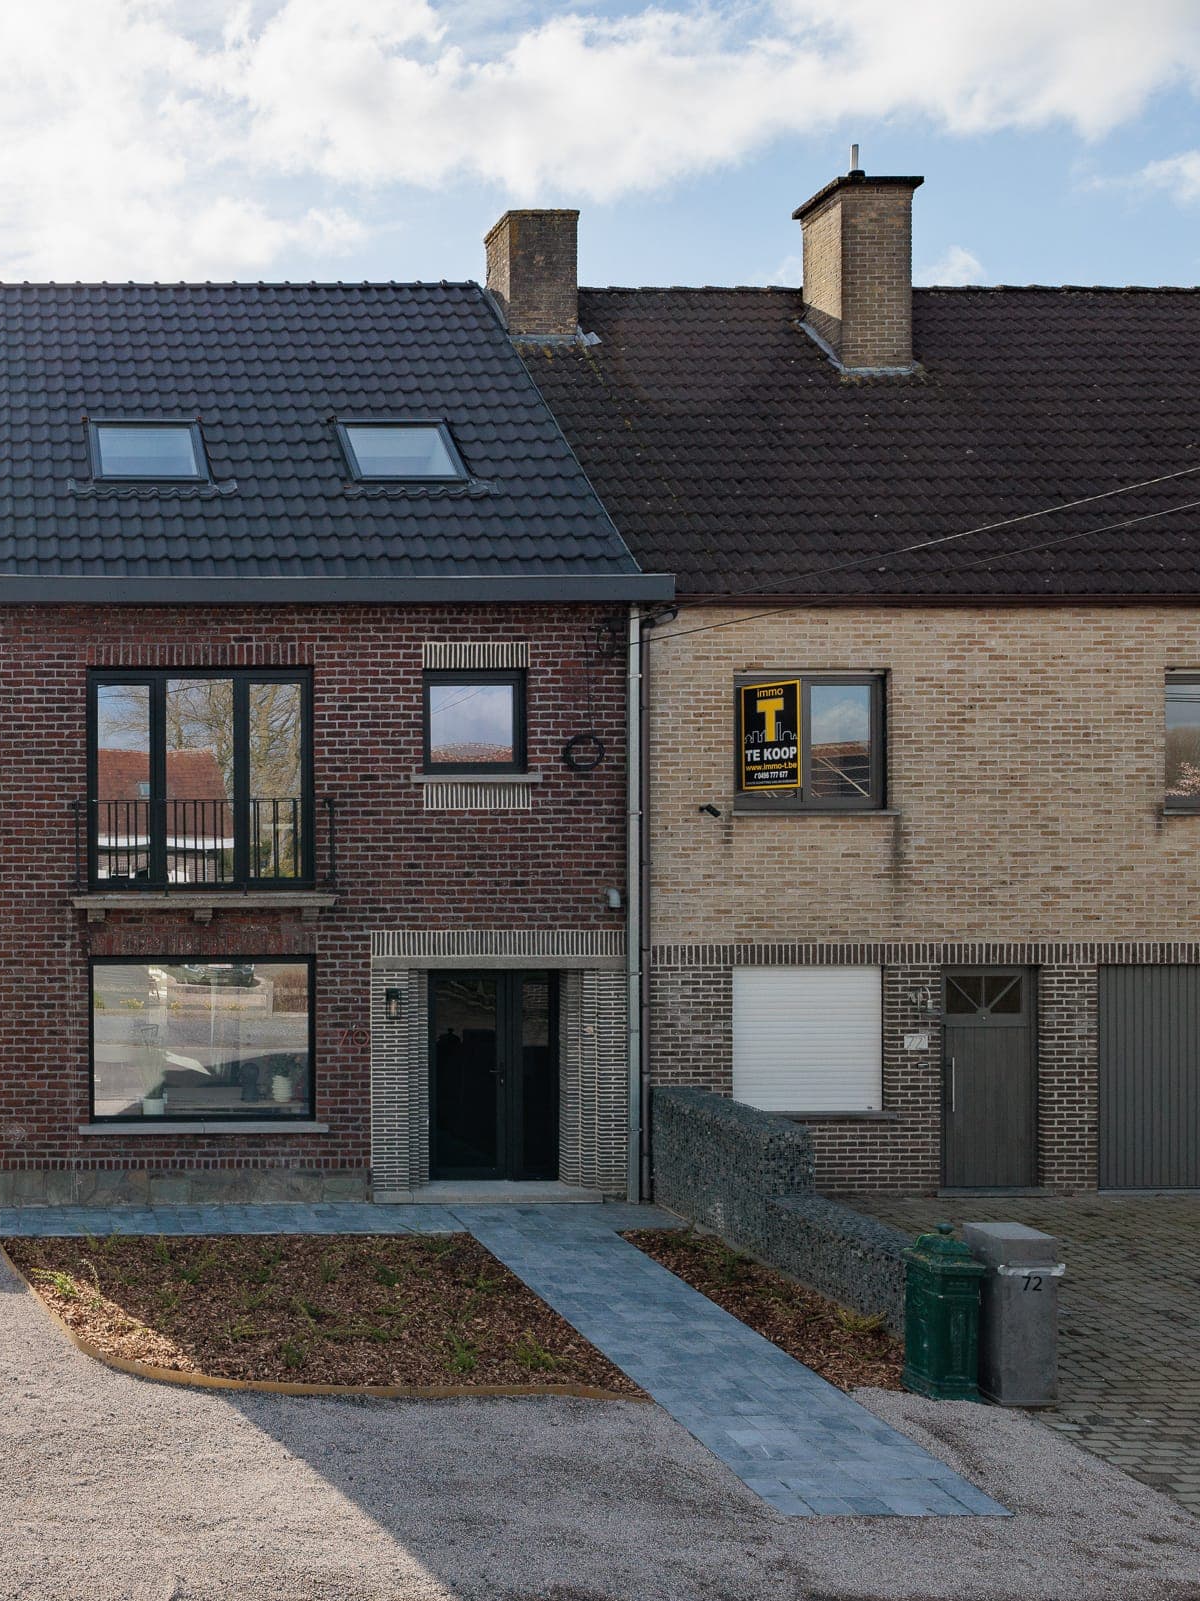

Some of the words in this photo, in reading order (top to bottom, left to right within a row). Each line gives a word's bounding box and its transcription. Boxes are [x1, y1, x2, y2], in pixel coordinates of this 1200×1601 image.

[757, 687, 784, 698] immo
[756, 697, 784, 742] T
[745, 749, 761, 762] TE
[764, 746, 797, 761] KOOP
[745, 762, 797, 772] www.immo-t.be
[1022, 1276, 1042, 1291] 72
